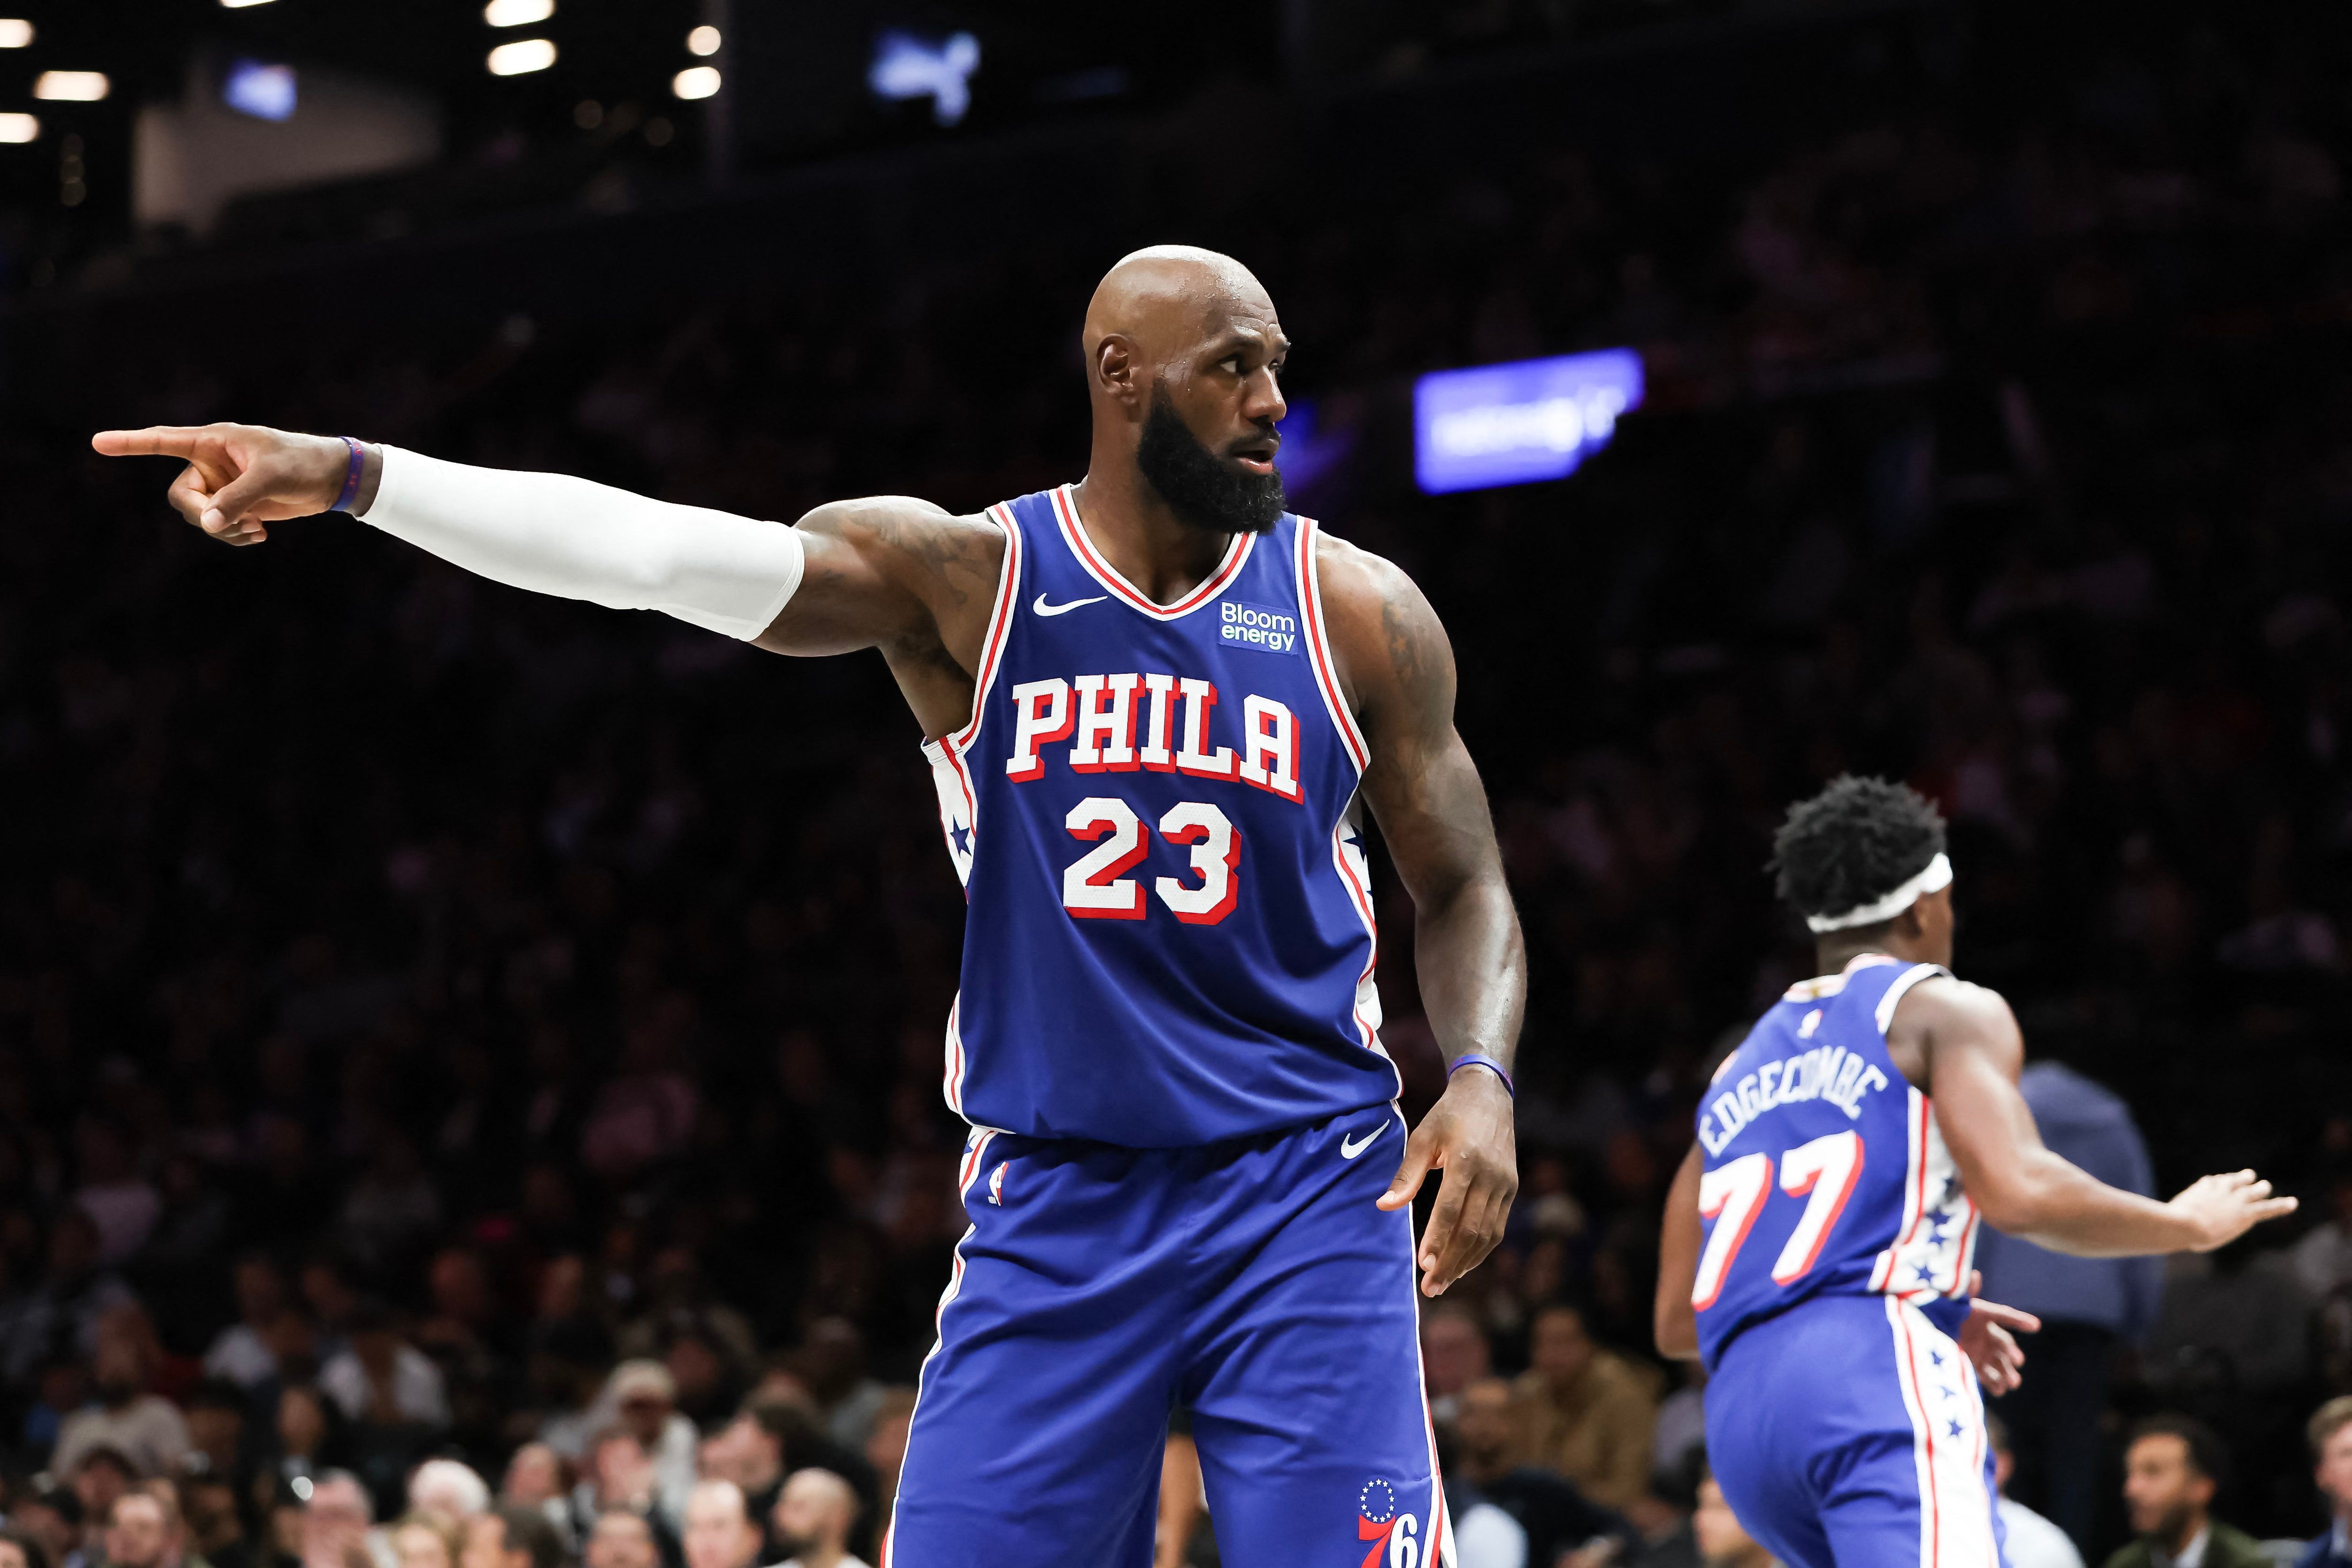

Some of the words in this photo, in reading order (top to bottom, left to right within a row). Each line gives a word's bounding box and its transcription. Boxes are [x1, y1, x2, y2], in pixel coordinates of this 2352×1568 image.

[1221, 601, 1296, 633] Bloom
[1221, 624, 1296, 652] energy
[1006, 672, 1304, 804] PHILA
[1063, 797, 1242, 926] 23
[1698, 1045, 1889, 1158] EDGECOMBE
[1691, 1130, 1864, 1312] 77
[1358, 1512, 1418, 1568] 76
